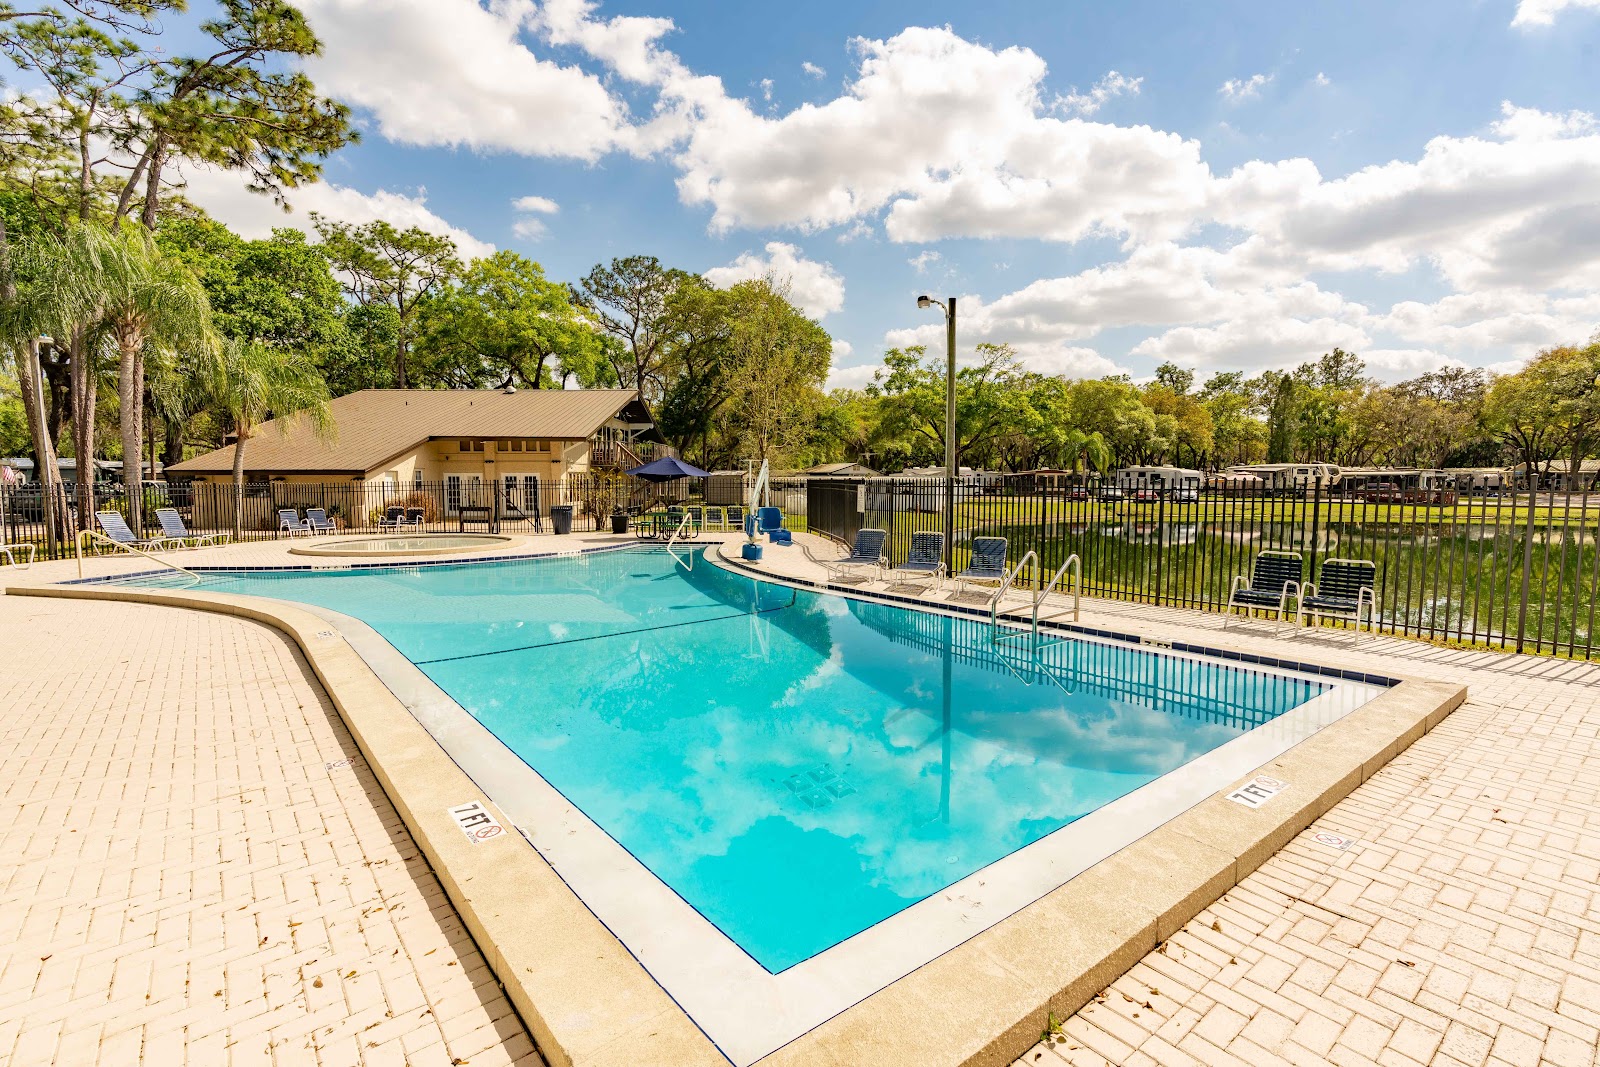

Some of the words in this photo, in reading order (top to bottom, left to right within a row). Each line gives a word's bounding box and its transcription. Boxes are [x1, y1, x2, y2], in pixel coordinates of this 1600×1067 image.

[1243, 784, 1273, 798] FT
[1232, 793, 1257, 804] 7
[455, 804, 479, 813] 7
[460, 813, 491, 828] FT
